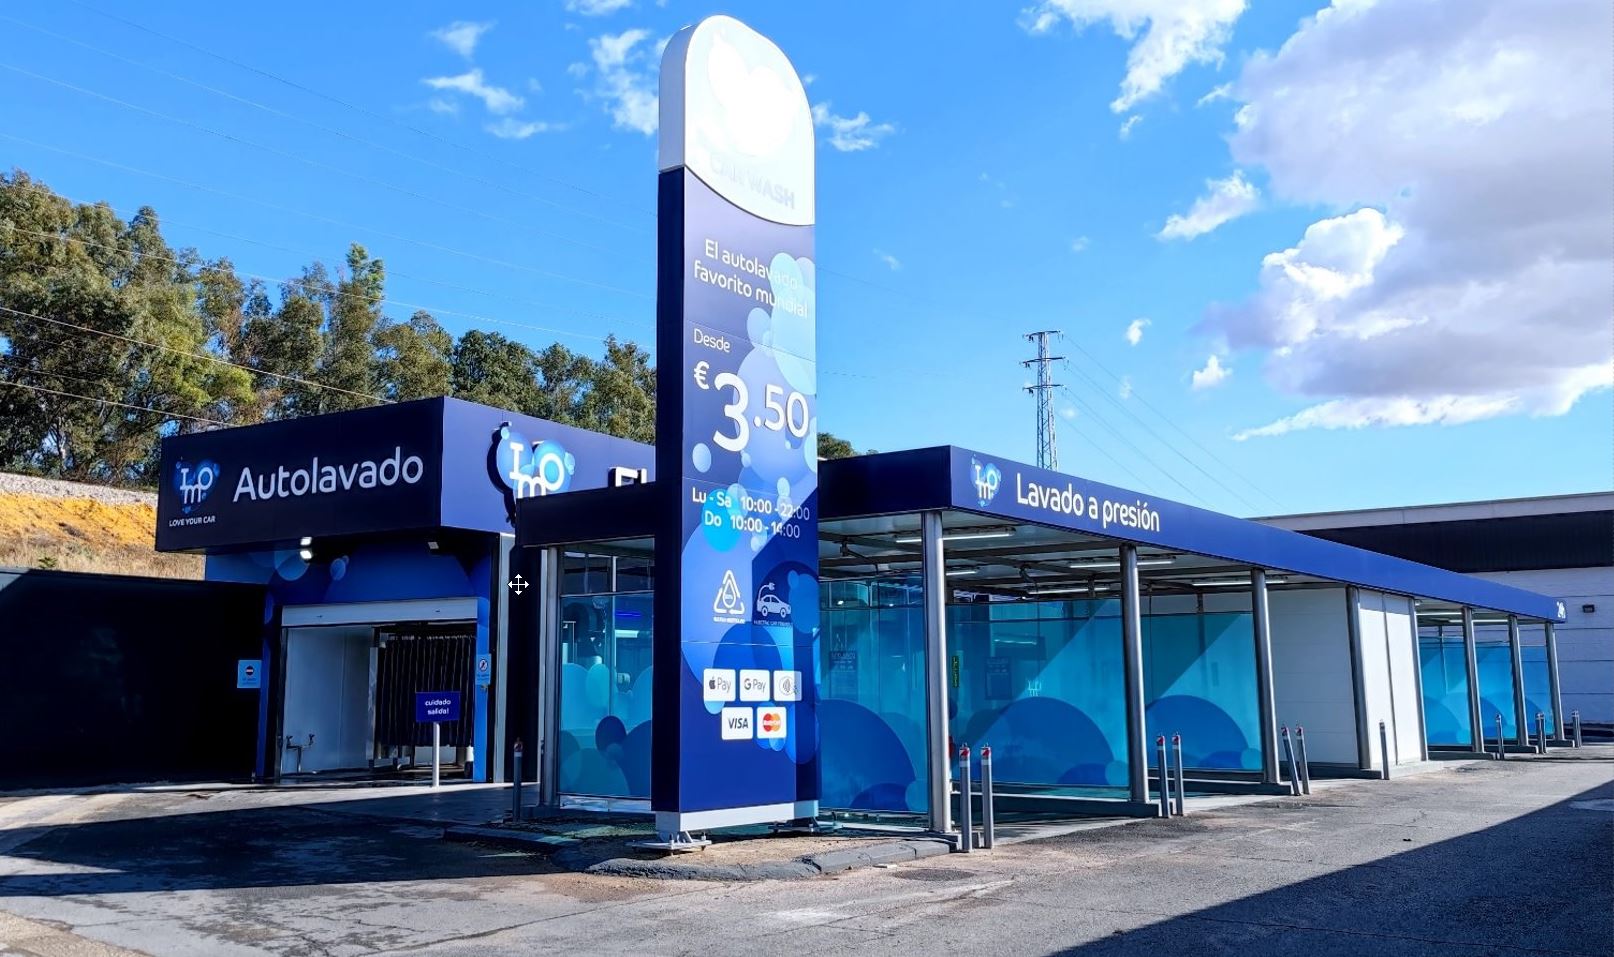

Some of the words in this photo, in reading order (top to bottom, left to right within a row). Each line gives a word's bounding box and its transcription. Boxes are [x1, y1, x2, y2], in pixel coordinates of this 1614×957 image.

[748, 175, 795, 210] WASH
[705, 238, 719, 260] El
[694, 259, 753, 298] favorito
[693, 327, 731, 353] Desde
[232, 446, 424, 503] Autolavado
[692, 487, 707, 504] Lu
[716, 491, 732, 508] Sa
[740, 496, 772, 514] 10:00
[780, 502, 811, 521] 22:00
[1016, 472, 1085, 516] Lavado
[1088, 496, 1099, 520] a
[1102, 499, 1161, 532] presión
[168, 518, 185, 527] LOVE
[185, 516, 202, 526] YOUR
[203, 515, 216, 524] CAR
[704, 510, 722, 527] Do
[730, 515, 763, 533] 10:00
[770, 521, 801, 539] 14:00
[717, 676, 732, 694] Pay
[752, 678, 767, 694] Pay
[424, 698, 452, 706] cuidado
[727, 717, 749, 730] VISA
